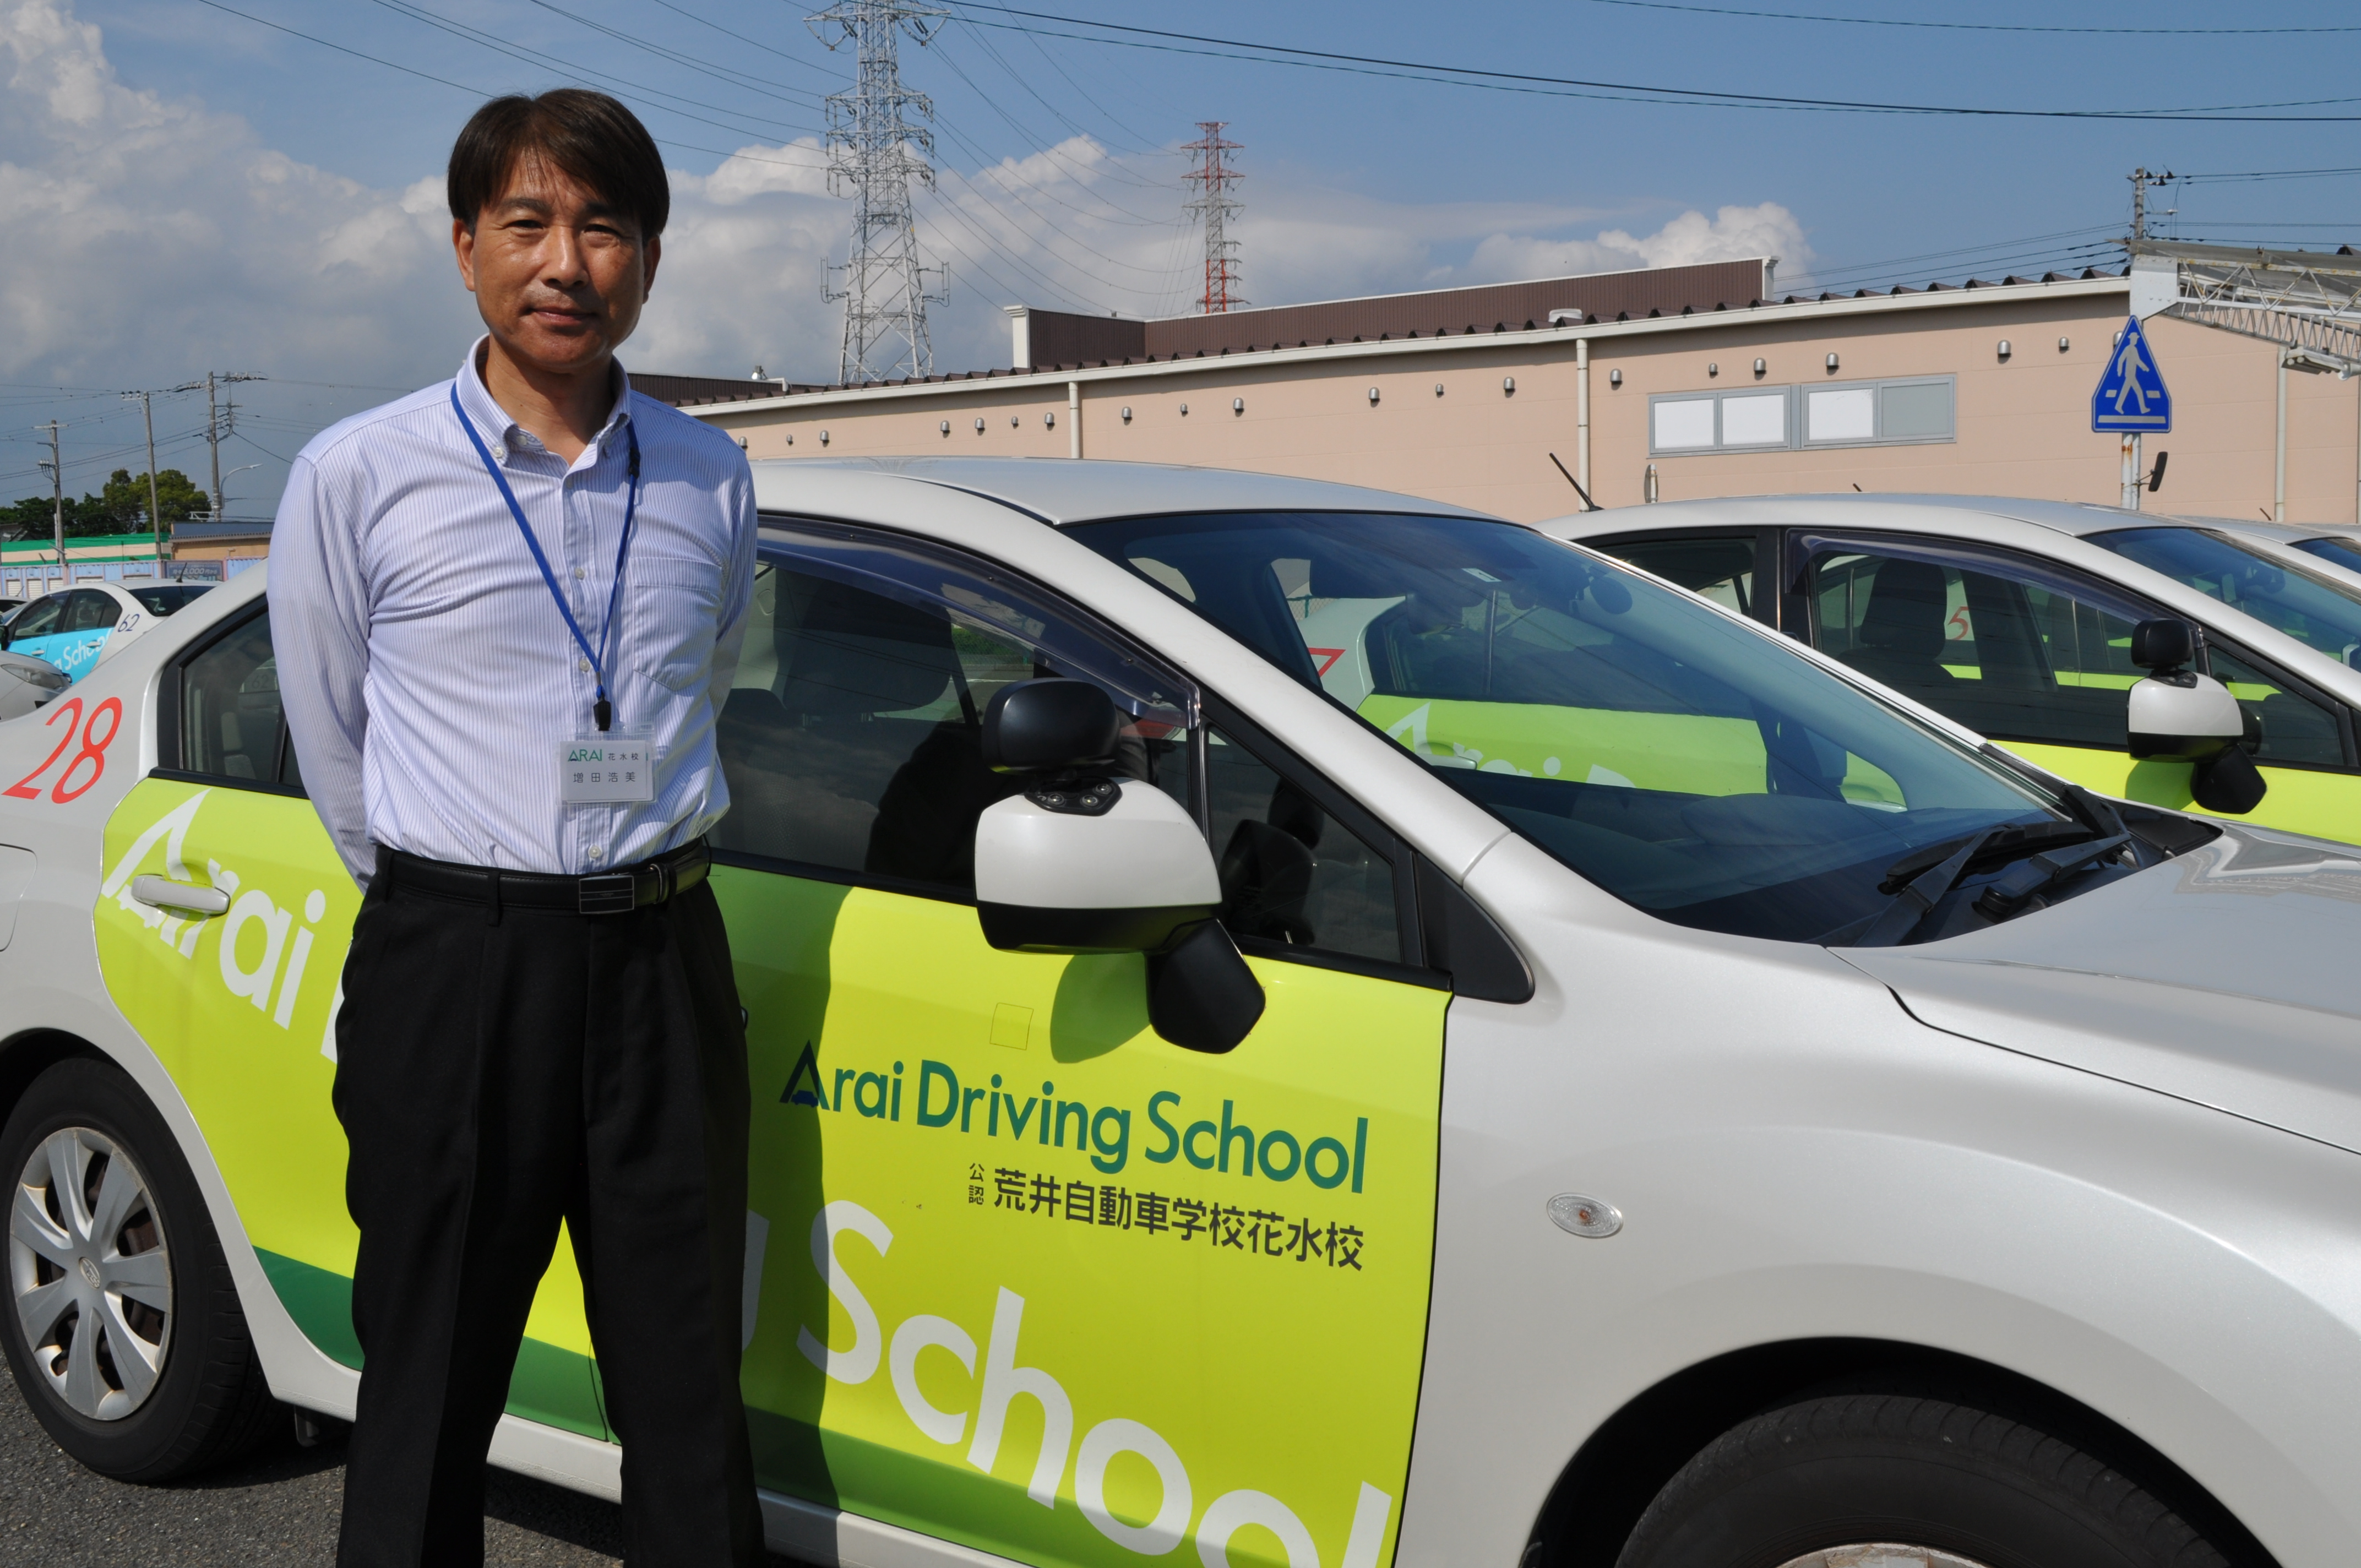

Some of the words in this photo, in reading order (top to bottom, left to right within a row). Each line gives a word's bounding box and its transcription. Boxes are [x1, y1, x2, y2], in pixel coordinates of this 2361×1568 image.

[118, 614, 140, 633] 62
[1, 697, 122, 804] 28
[568, 749, 602, 761] ARAI
[608, 753, 639, 761] 花水校
[573, 771, 635, 783] 増田浩美
[780, 1039, 903, 1122] Arai
[917, 1059, 1131, 1174] Driving
[1144, 1090, 1368, 1194] School
[969, 1163, 984, 1205] 公認
[994, 1167, 1364, 1271] 荒井自動車学校花水校
